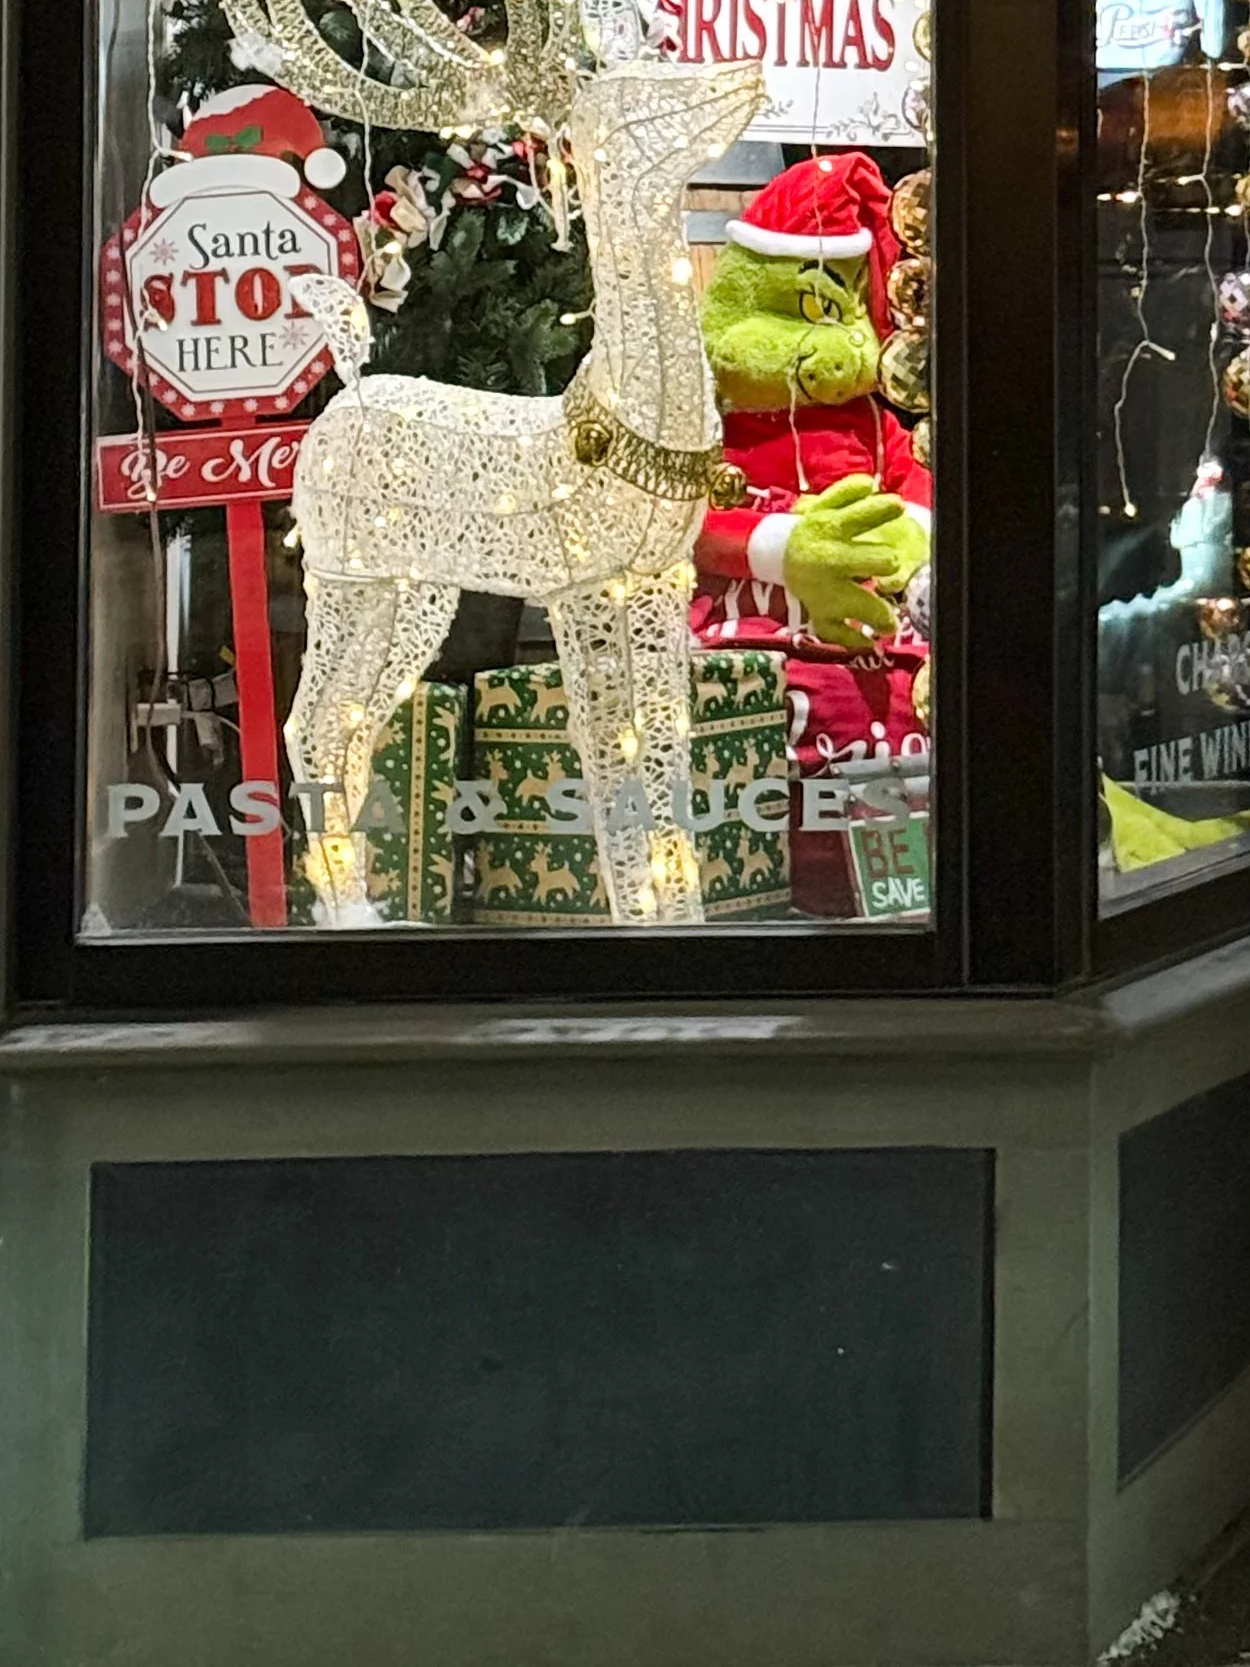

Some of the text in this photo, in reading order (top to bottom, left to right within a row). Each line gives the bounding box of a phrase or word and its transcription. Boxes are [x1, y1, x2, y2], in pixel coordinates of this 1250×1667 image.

[186, 220, 302, 272] Santa
[176, 333, 284, 373] HERE
[121, 444, 190, 499] Be
[1134, 737, 1193, 796] FINE
[106, 777, 913, 837] PASTA & SAUCES
[860, 827, 916, 878] BE
[872, 876, 925, 909] SAVE
